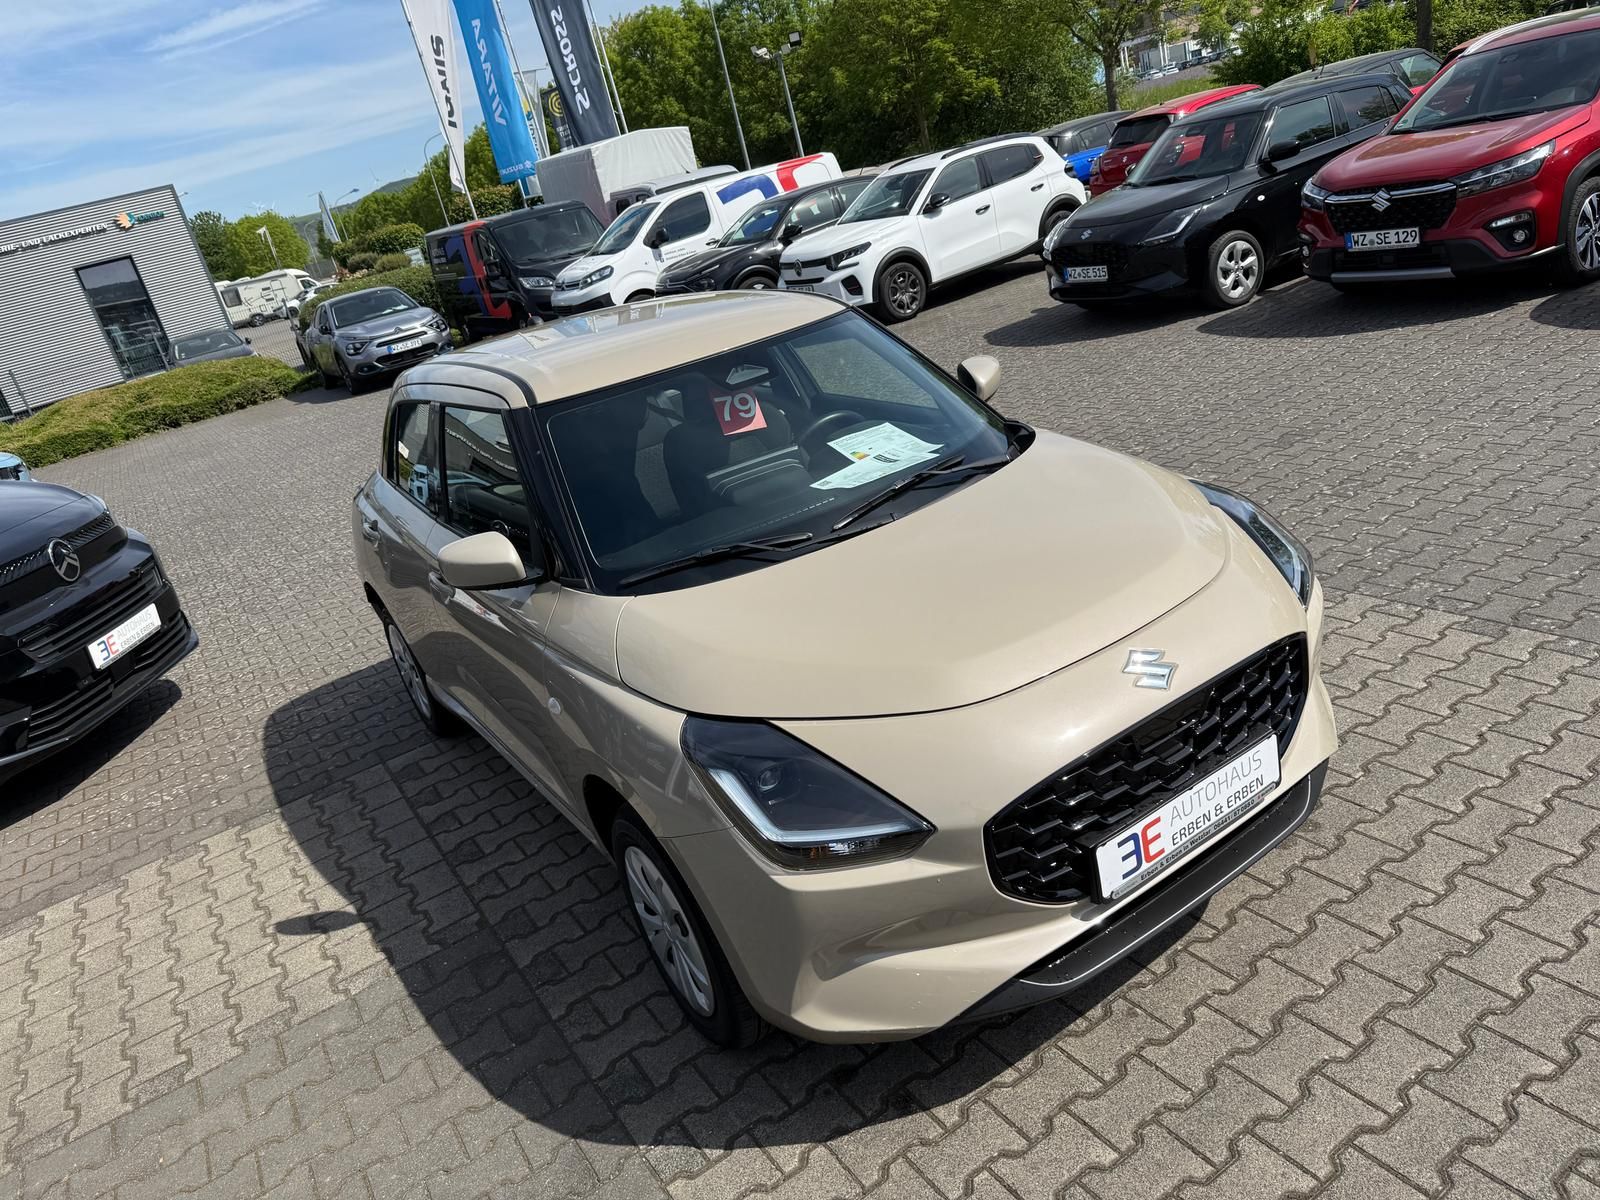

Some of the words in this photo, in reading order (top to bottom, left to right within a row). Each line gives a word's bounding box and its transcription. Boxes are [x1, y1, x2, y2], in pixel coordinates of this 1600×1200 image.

[22, 237, 41, 248] UND
[42, 222, 108, 243] LACKEXPERTEN
[1352, 233, 1368, 247] WZ
[1375, 231, 1391, 245] SE
[1394, 229, 1418, 244] 129
[1081, 267, 1091, 279] SE
[1092, 266, 1107, 278] 515
[713, 392, 757, 422] 79
[1170, 749, 1262, 827] AUTOHAUS
[1171, 810, 1212, 846] ERBEN
[1214, 803, 1224, 818] &
[1226, 774, 1264, 809] ERBEN
[1140, 865, 1159, 880] Erben
[1165, 849, 1183, 864] Erben
